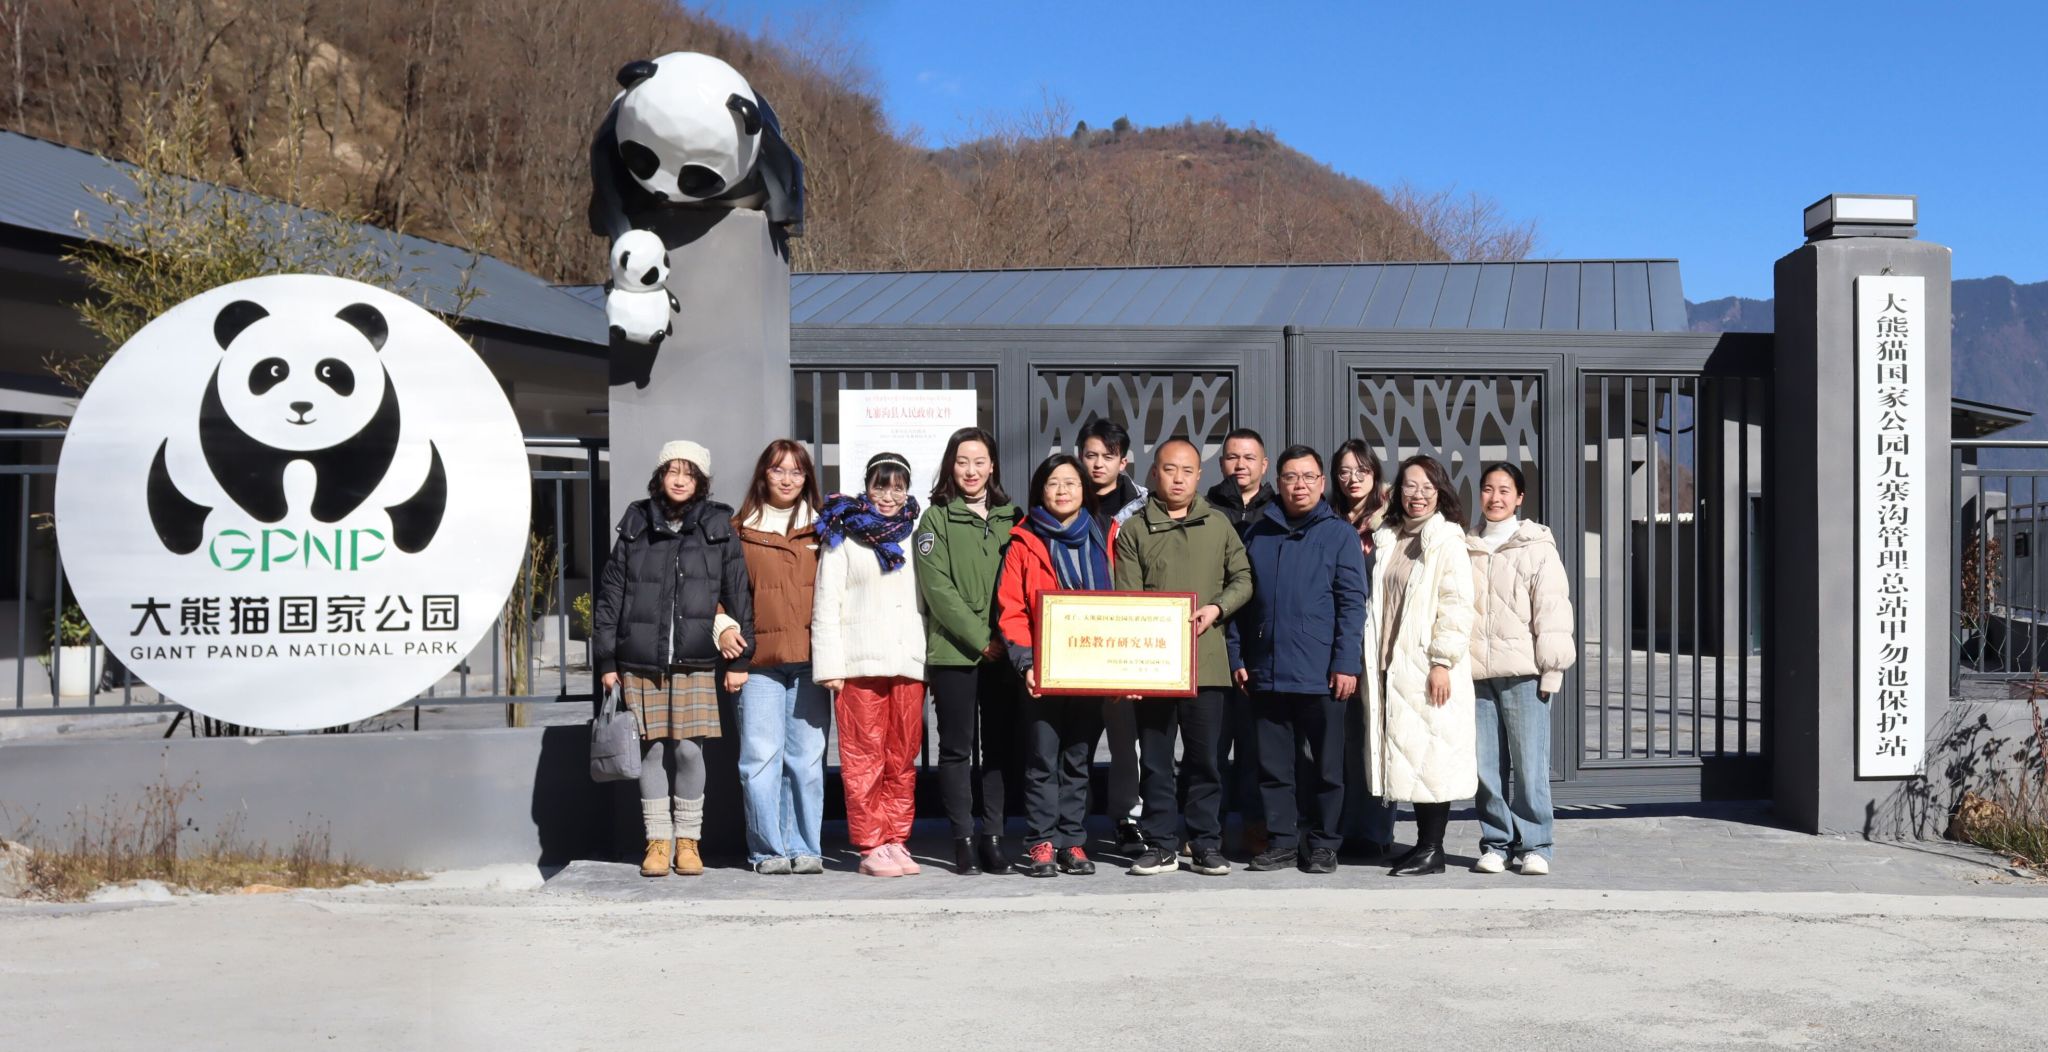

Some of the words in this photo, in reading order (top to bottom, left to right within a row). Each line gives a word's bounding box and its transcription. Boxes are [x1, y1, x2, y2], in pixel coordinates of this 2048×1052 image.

[1875, 292, 1909, 757] 大熊猫国家公园九寨沟管理总站甲勿池保护站
[209, 528, 386, 572] GPNP
[130, 594, 460, 637] 大熊猫国家公园
[130, 645, 196, 660] GIANT
[207, 644, 278, 658] PANDA
[289, 642, 394, 657] NATIONAL
[404, 641, 458, 654] PARK
[1068, 635, 1167, 649] 自然教育研究基地
